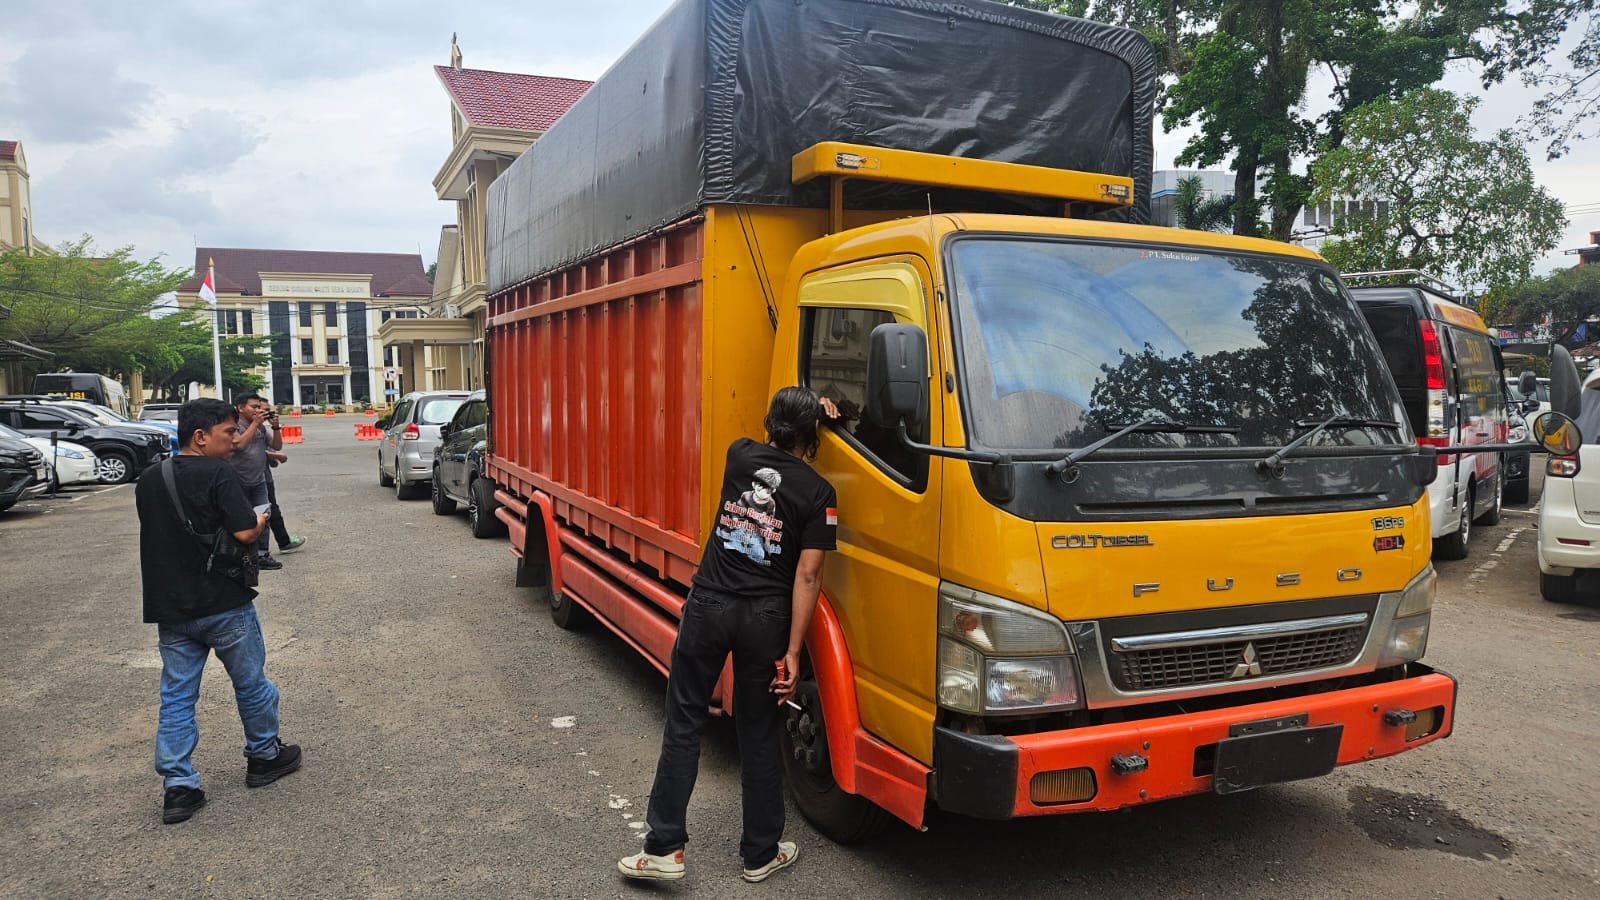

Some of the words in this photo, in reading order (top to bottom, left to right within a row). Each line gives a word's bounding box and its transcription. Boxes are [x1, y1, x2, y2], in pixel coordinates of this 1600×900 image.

[1370, 517, 1404, 531] 136PS
[1052, 534, 1101, 549] COLT
[1102, 534, 1154, 547] DIESEL
[1133, 568, 1362, 598] FUSO
